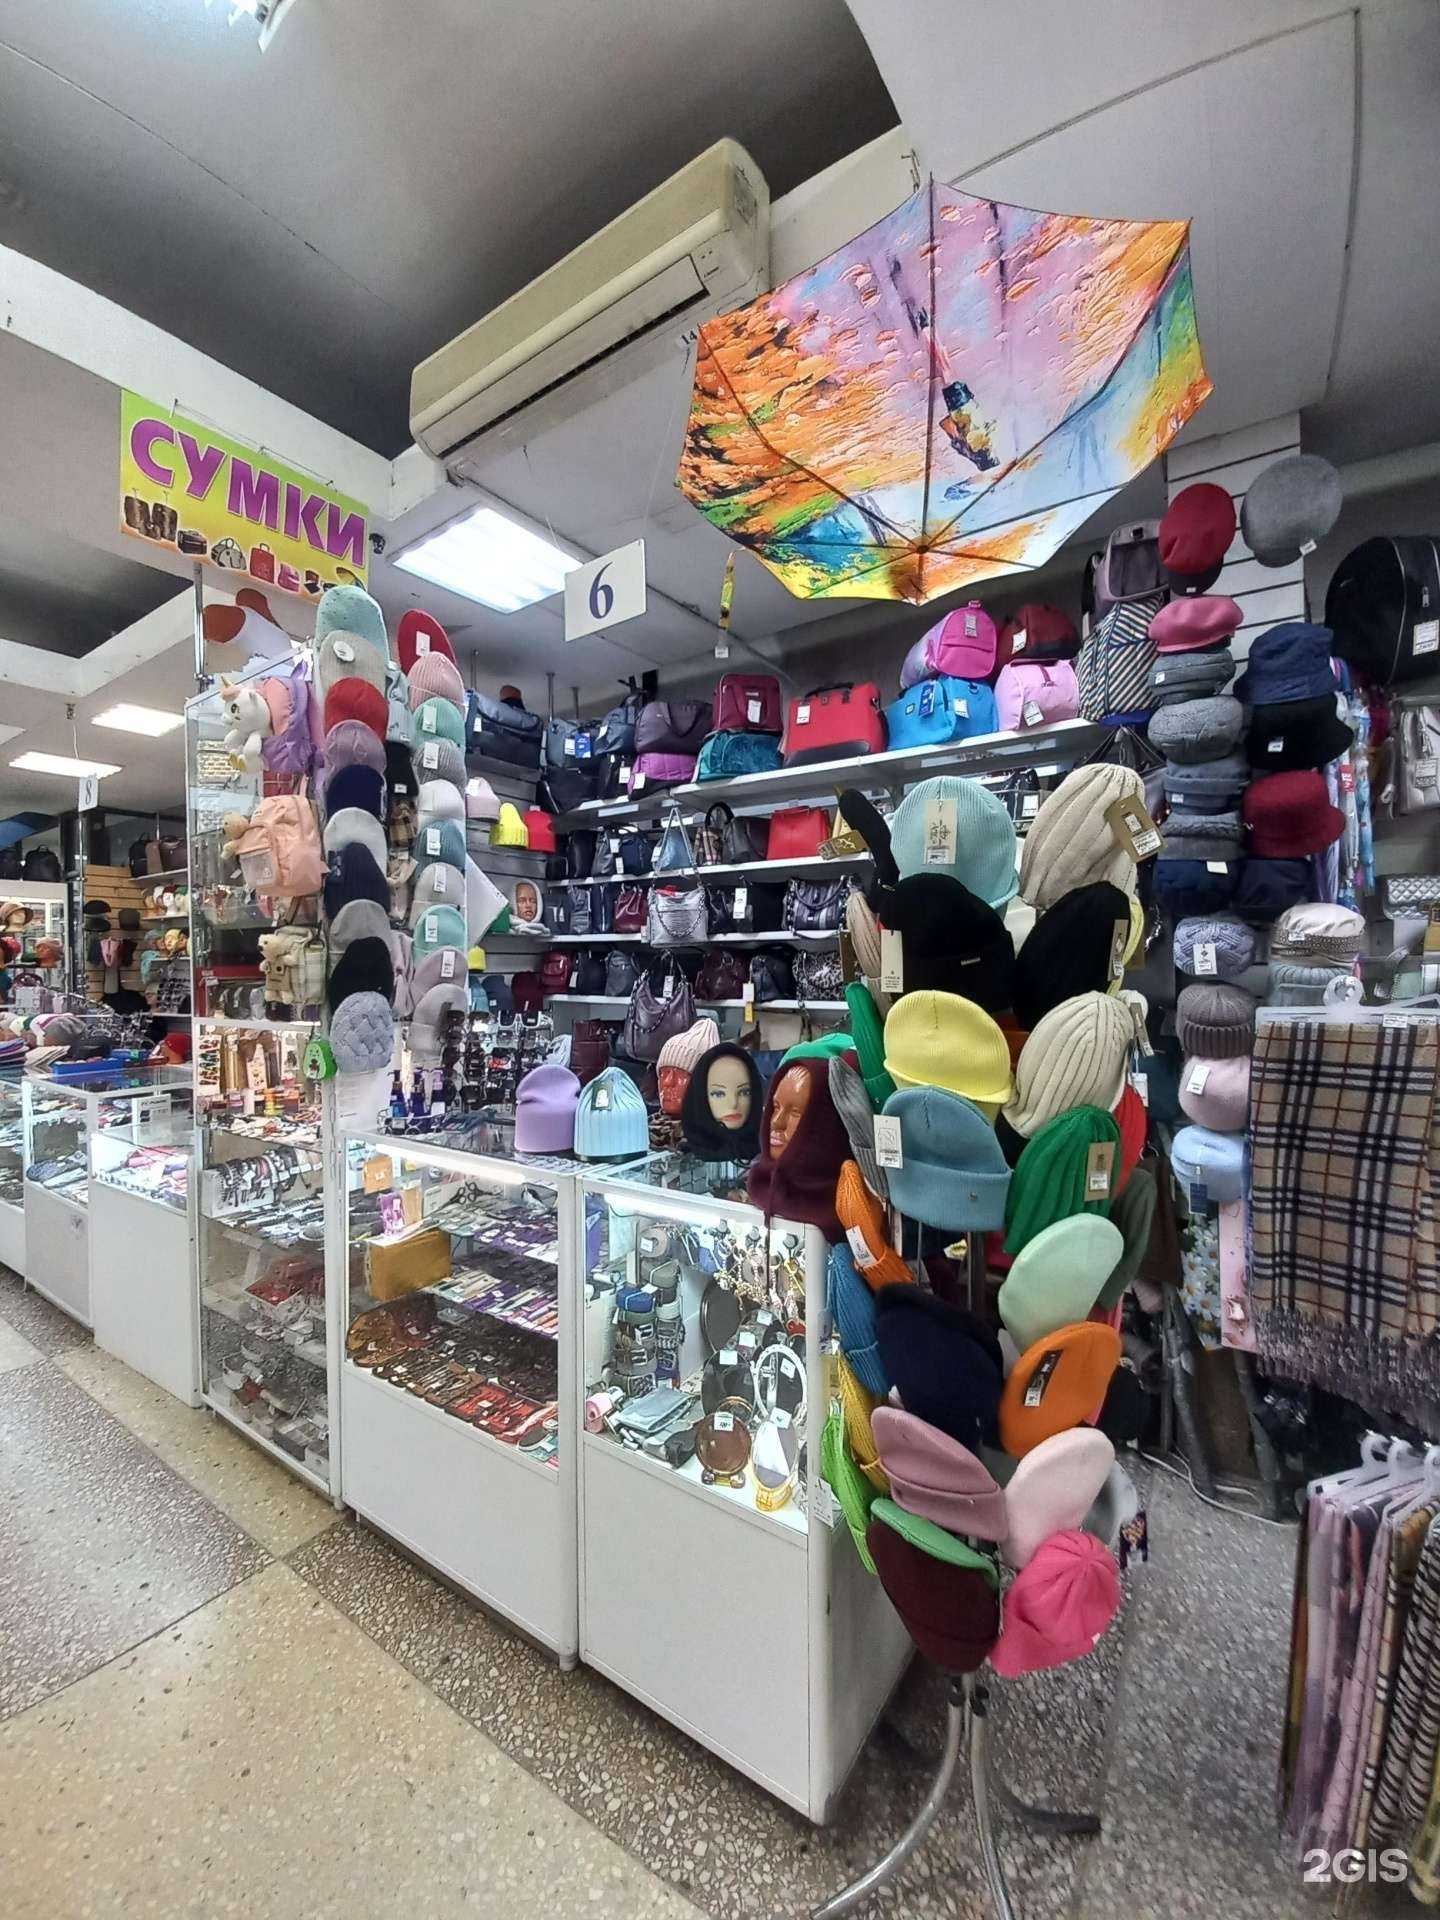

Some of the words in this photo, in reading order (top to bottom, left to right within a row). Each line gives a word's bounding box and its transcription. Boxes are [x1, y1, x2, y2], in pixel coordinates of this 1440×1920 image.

[130, 418, 365, 569] СУМКИ
[589, 561, 614, 619] 6
[85, 779, 92, 805] 8
